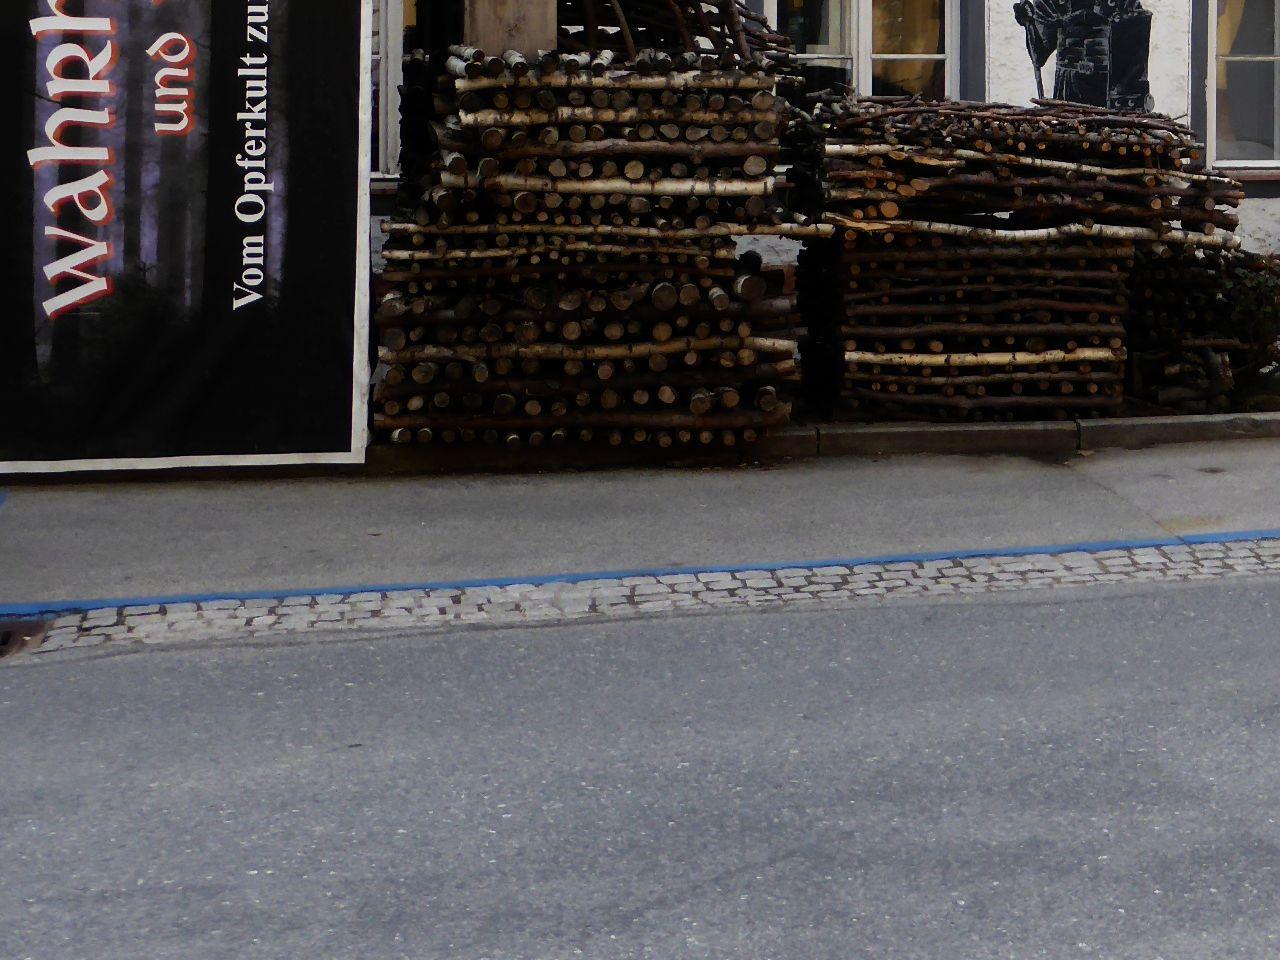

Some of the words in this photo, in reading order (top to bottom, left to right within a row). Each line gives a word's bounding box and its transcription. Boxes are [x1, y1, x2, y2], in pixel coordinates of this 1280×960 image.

[145, 31, 193, 135] und
[234, 52, 275, 224] Opferkult
[232, 235, 265, 311] Vom
